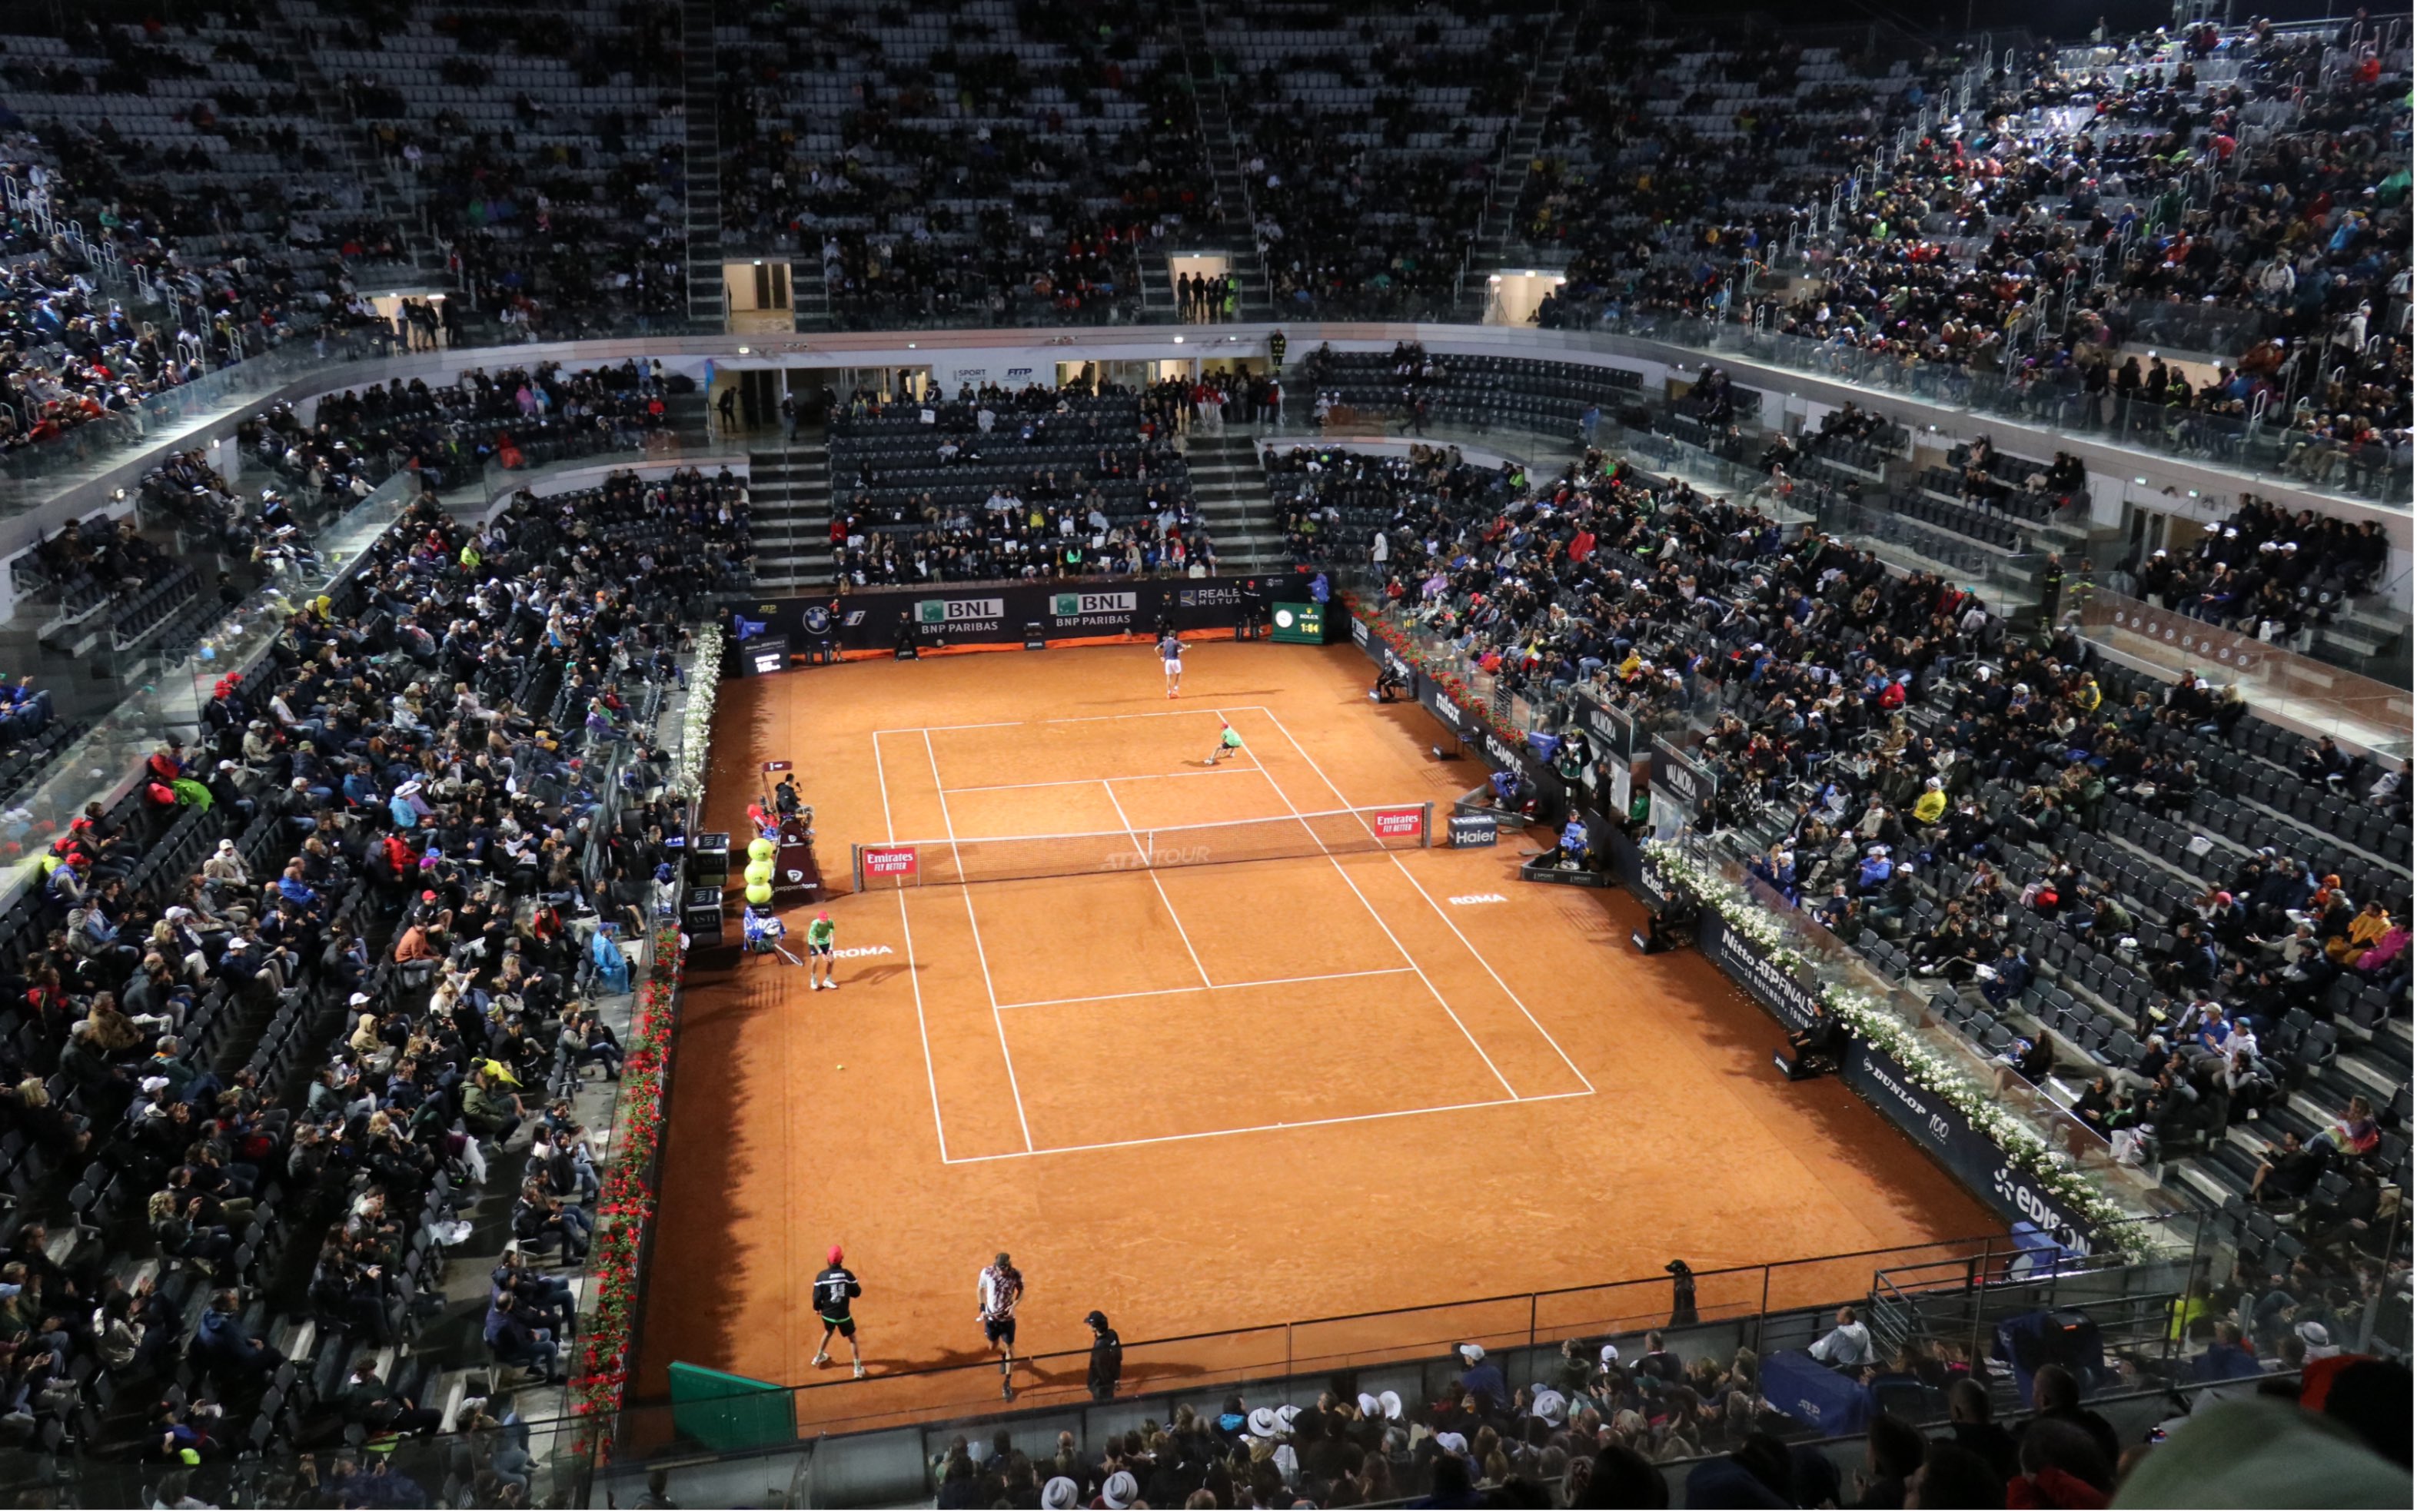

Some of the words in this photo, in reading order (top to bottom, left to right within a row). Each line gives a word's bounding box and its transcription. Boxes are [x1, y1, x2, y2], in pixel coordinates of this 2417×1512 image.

[1198, 588, 1241, 599] REALE
[947, 601, 997, 618] BNL
[1082, 595, 1130, 611] BNL
[922, 624, 946, 634] BNP
[948, 621, 999, 633] PARIBAS
[1056, 617, 1080, 627] BNP
[1082, 615, 1131, 626] PARIBAS
[1301, 623, 1318, 633] 1:04
[1436, 692, 1460, 726] nilox
[1590, 710, 1617, 741] VALMORA
[1666, 764, 1697, 799] VALMORA
[1377, 815, 1419, 826] Emirates
[1393, 823, 1413, 832] BETTER
[1455, 831, 1496, 843] Haier
[866, 852, 913, 864] Emirates
[1153, 846, 1212, 865] TOUR
[886, 862, 907, 871] BETTER
[775, 883, 817, 892] pepperstone
[1448, 894, 1508, 905] ROMA
[833, 945, 893, 959] ROMA
[1722, 929, 1755, 966] Nitto
[1754, 976, 1787, 1012] NOVEMBER,
[1872, 1067, 1927, 1115] DUNLOP
[1928, 1113, 1950, 1138] 100
